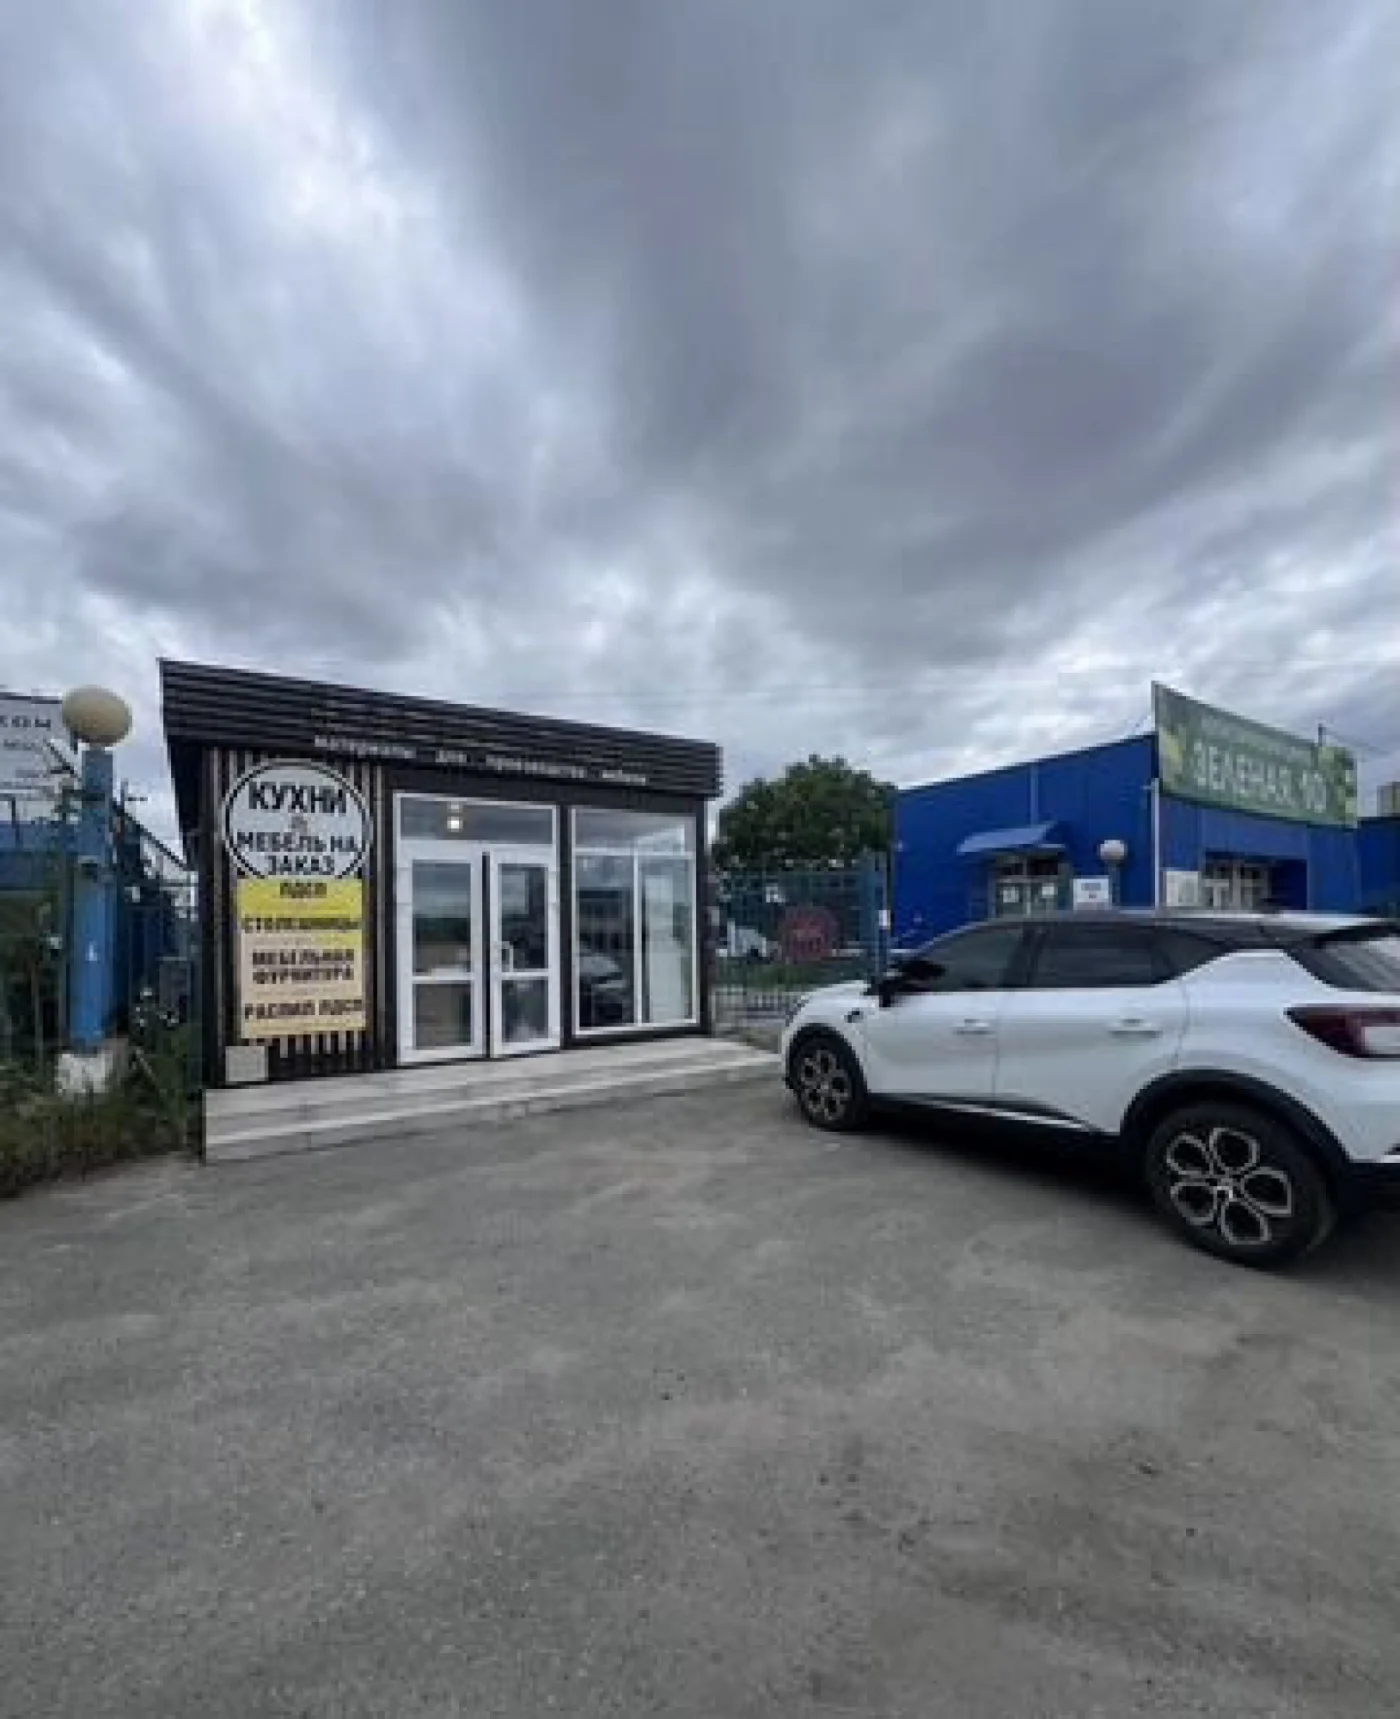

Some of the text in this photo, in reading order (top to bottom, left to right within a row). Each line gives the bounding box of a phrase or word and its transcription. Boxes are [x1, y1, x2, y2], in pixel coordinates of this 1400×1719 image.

[248, 781, 347, 814] КУХНИ
[235, 831, 359, 853] МЕБЕЛЬ НА
[267, 855, 335, 876] ЗАКАЗ
[252, 948, 355, 965] МЕБЕЛЬНАЯ
